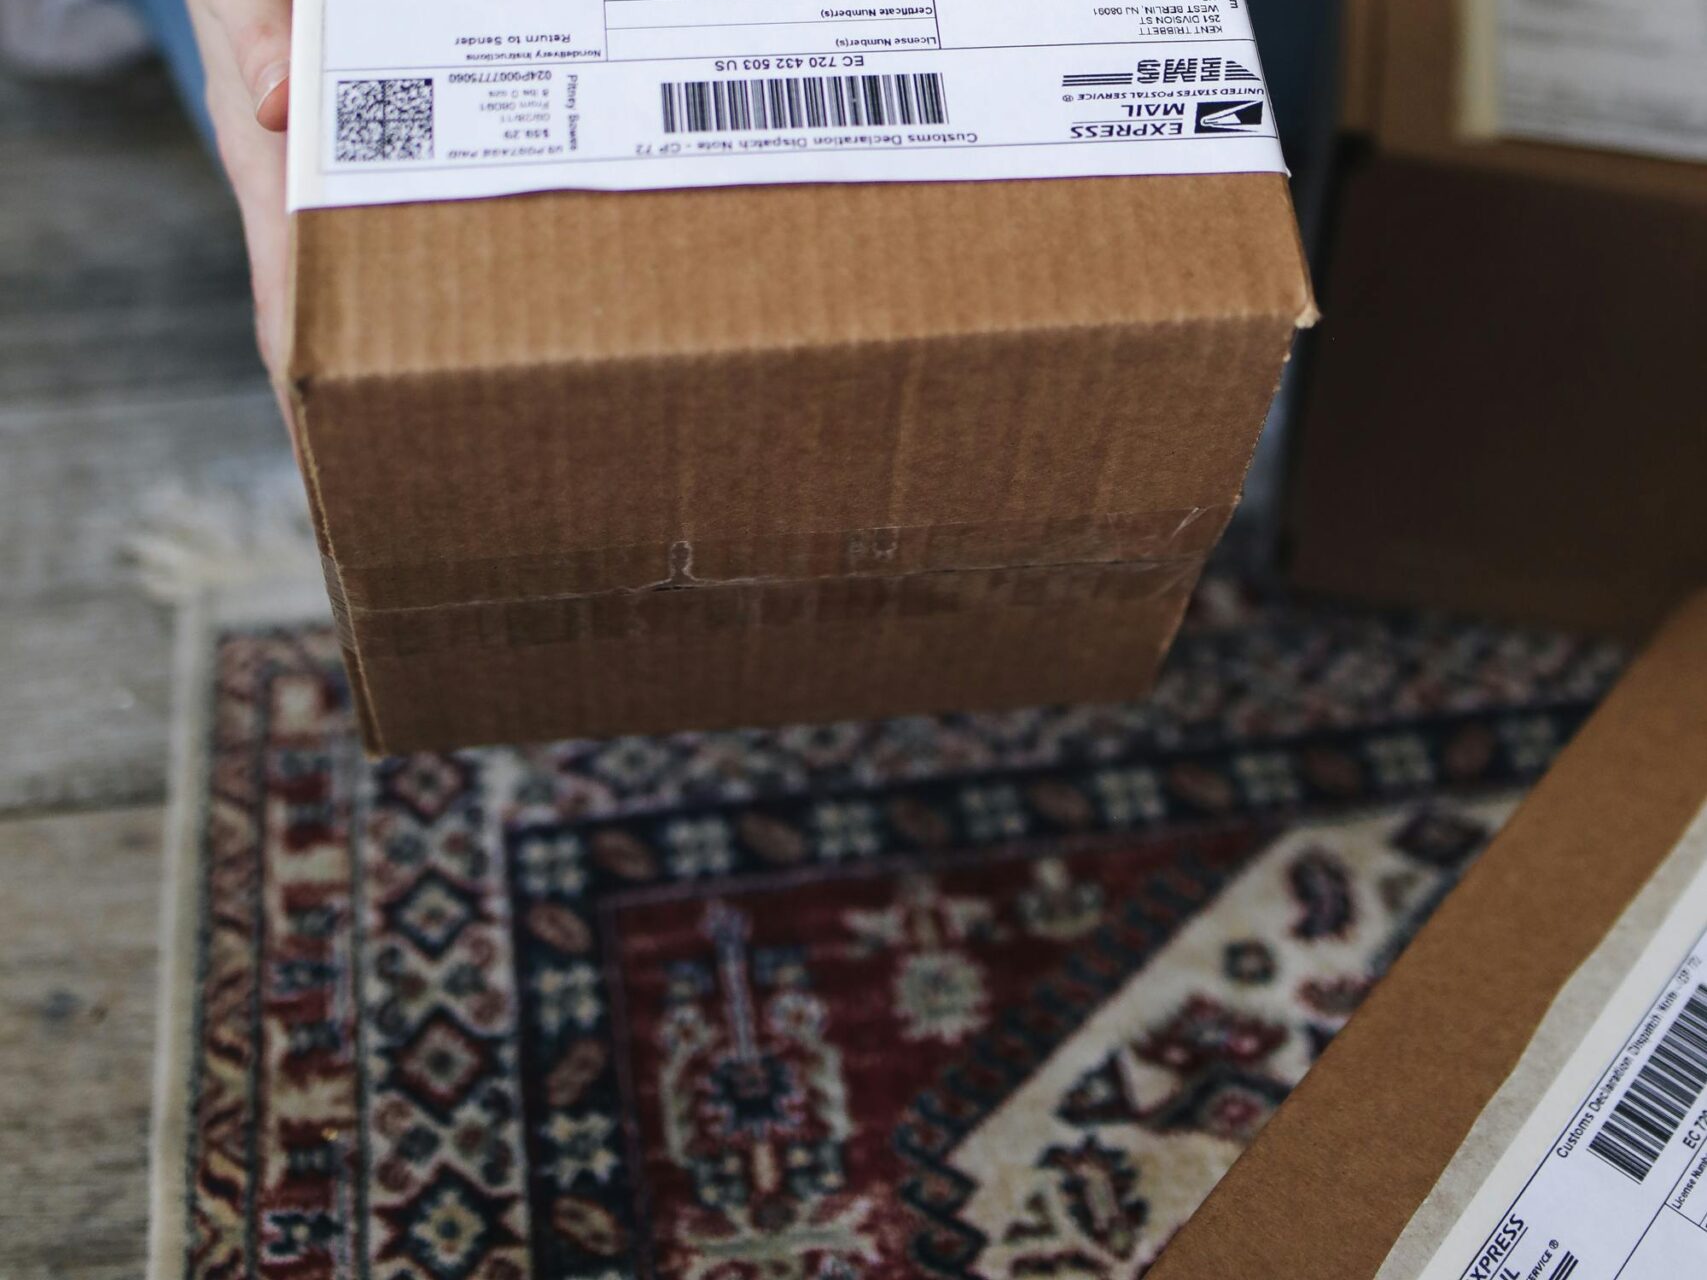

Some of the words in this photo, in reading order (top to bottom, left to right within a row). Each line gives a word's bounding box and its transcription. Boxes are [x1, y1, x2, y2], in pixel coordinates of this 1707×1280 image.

[821, 8, 876, 19] Number(s)
[879, 6, 932, 16] Certificate
[1093, 7, 1122, 16] 08091
[1141, 6, 1183, 14] BERLIN,
[1187, 4, 1218, 13] WEST
[1156, 16, 1199, 24] DIVSION
[1138, 27, 1189, 35] TRIBBETT
[1194, 26, 1222, 34] KENT
[455, 36, 502, 46] Sender
[508, 35, 520, 43] to
[526, 34, 570, 44] Return
[835, 38, 891, 48] Number(s)
[894, 36, 936, 46] License
[466, 51, 532, 62] Instructions
[536, 49, 601, 60] Nondelivery
[715, 60, 737, 71] US
[743, 59, 770, 70] 503
[776, 58, 803, 69] 432
[808, 56, 836, 68] 720
[842, 55, 864, 67] EC
[1137, 57, 1221, 84] EMS
[566, 75, 578, 108] Pitney
[1121, 104, 1185, 116] MAIL
[1070, 123, 1182, 139] EXPRESS
[739, 137, 806, 150] Dispatch
[813, 135, 902, 146] Declaration
[907, 132, 978, 144] Customs
[636, 144, 652, 155] 72
[660, 142, 681, 153] CP
[698, 140, 733, 152] Note
[1557, 1112, 1594, 1158] Customs
[1589, 1056, 1633, 1111] Declaration
[1683, 1130, 1701, 1149] EC
[1672, 1178, 1696, 1210] License
[1469, 1214, 1524, 1280] XPRESS
[1526, 1249, 1552, 1280] ERVICE
